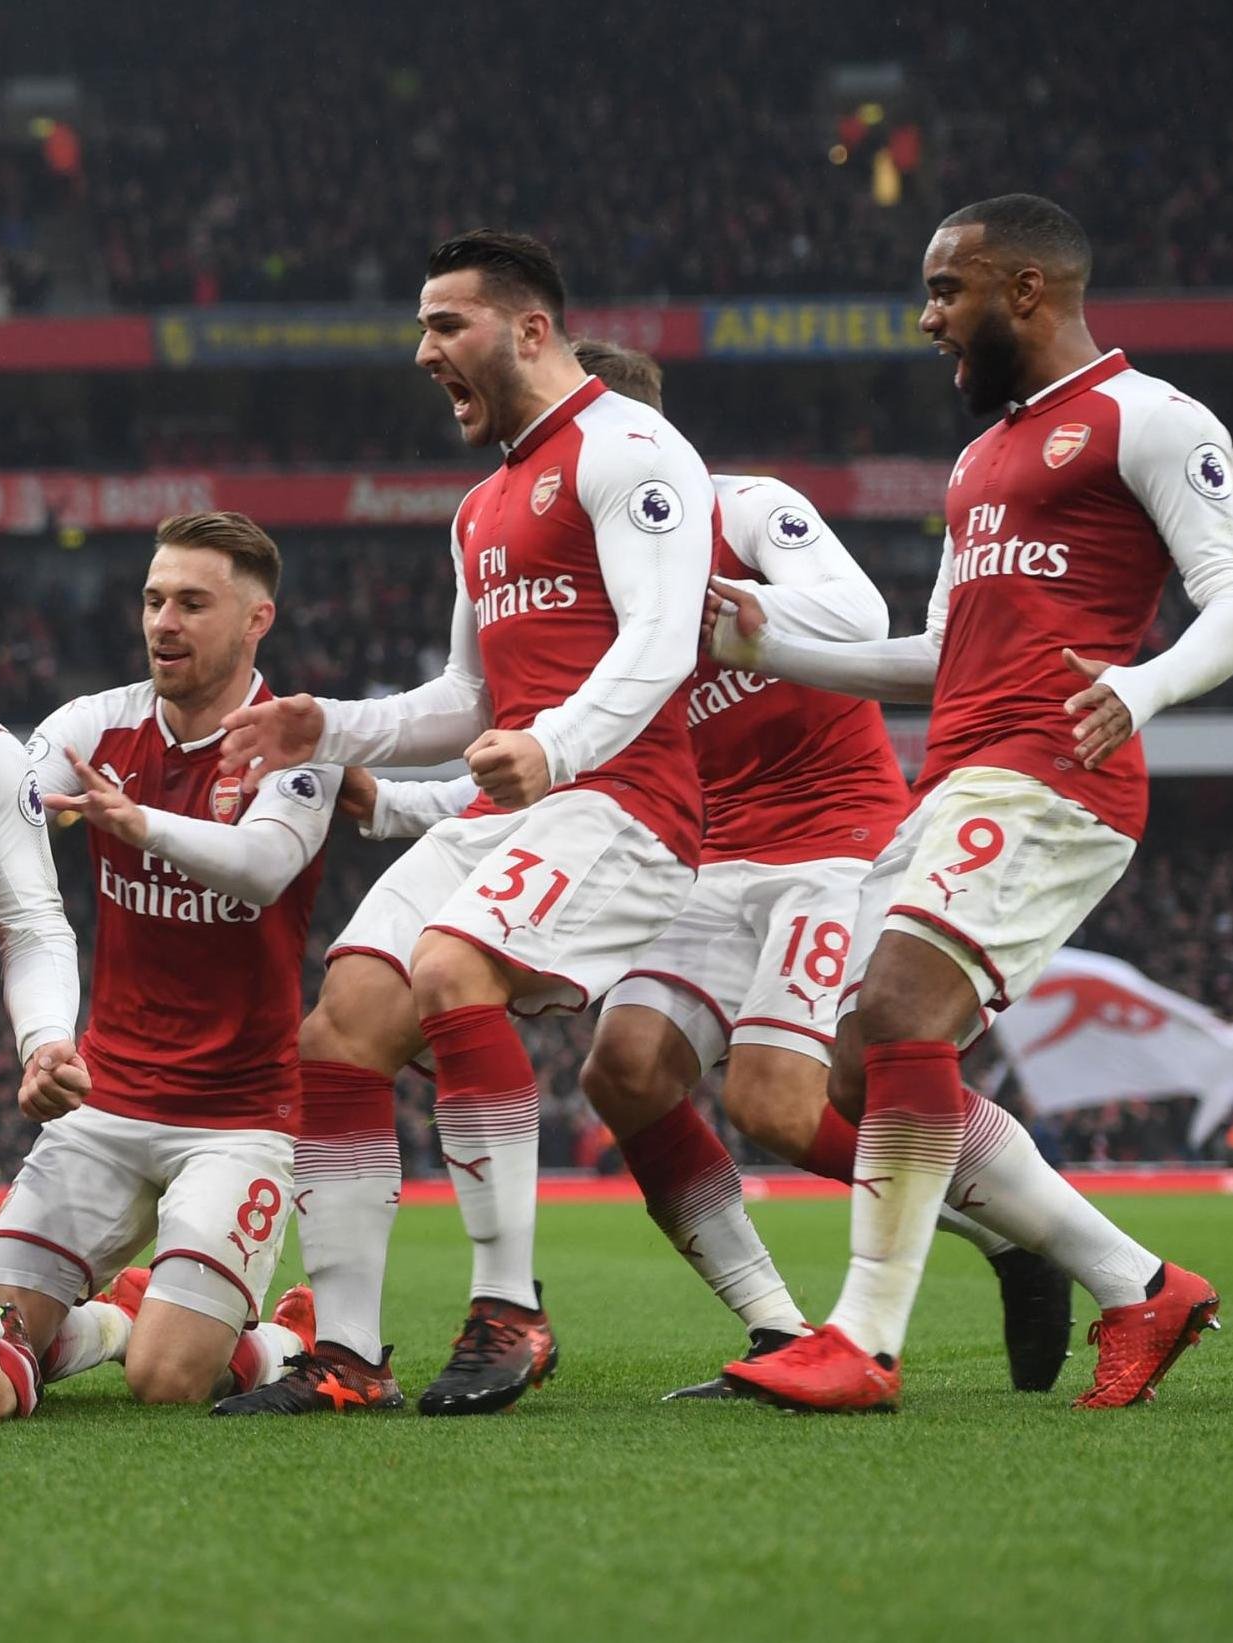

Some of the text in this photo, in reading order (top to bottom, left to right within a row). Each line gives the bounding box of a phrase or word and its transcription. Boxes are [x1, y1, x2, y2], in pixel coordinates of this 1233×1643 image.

[967, 503, 1007, 537] Fly
[479, 545, 507, 580] Fly
[944, 817, 1005, 876] 9
[99, 856, 262, 924] Emirates
[477, 848, 571, 927] 31
[779, 915, 851, 988] 18
[237, 1178, 281, 1242] 8
